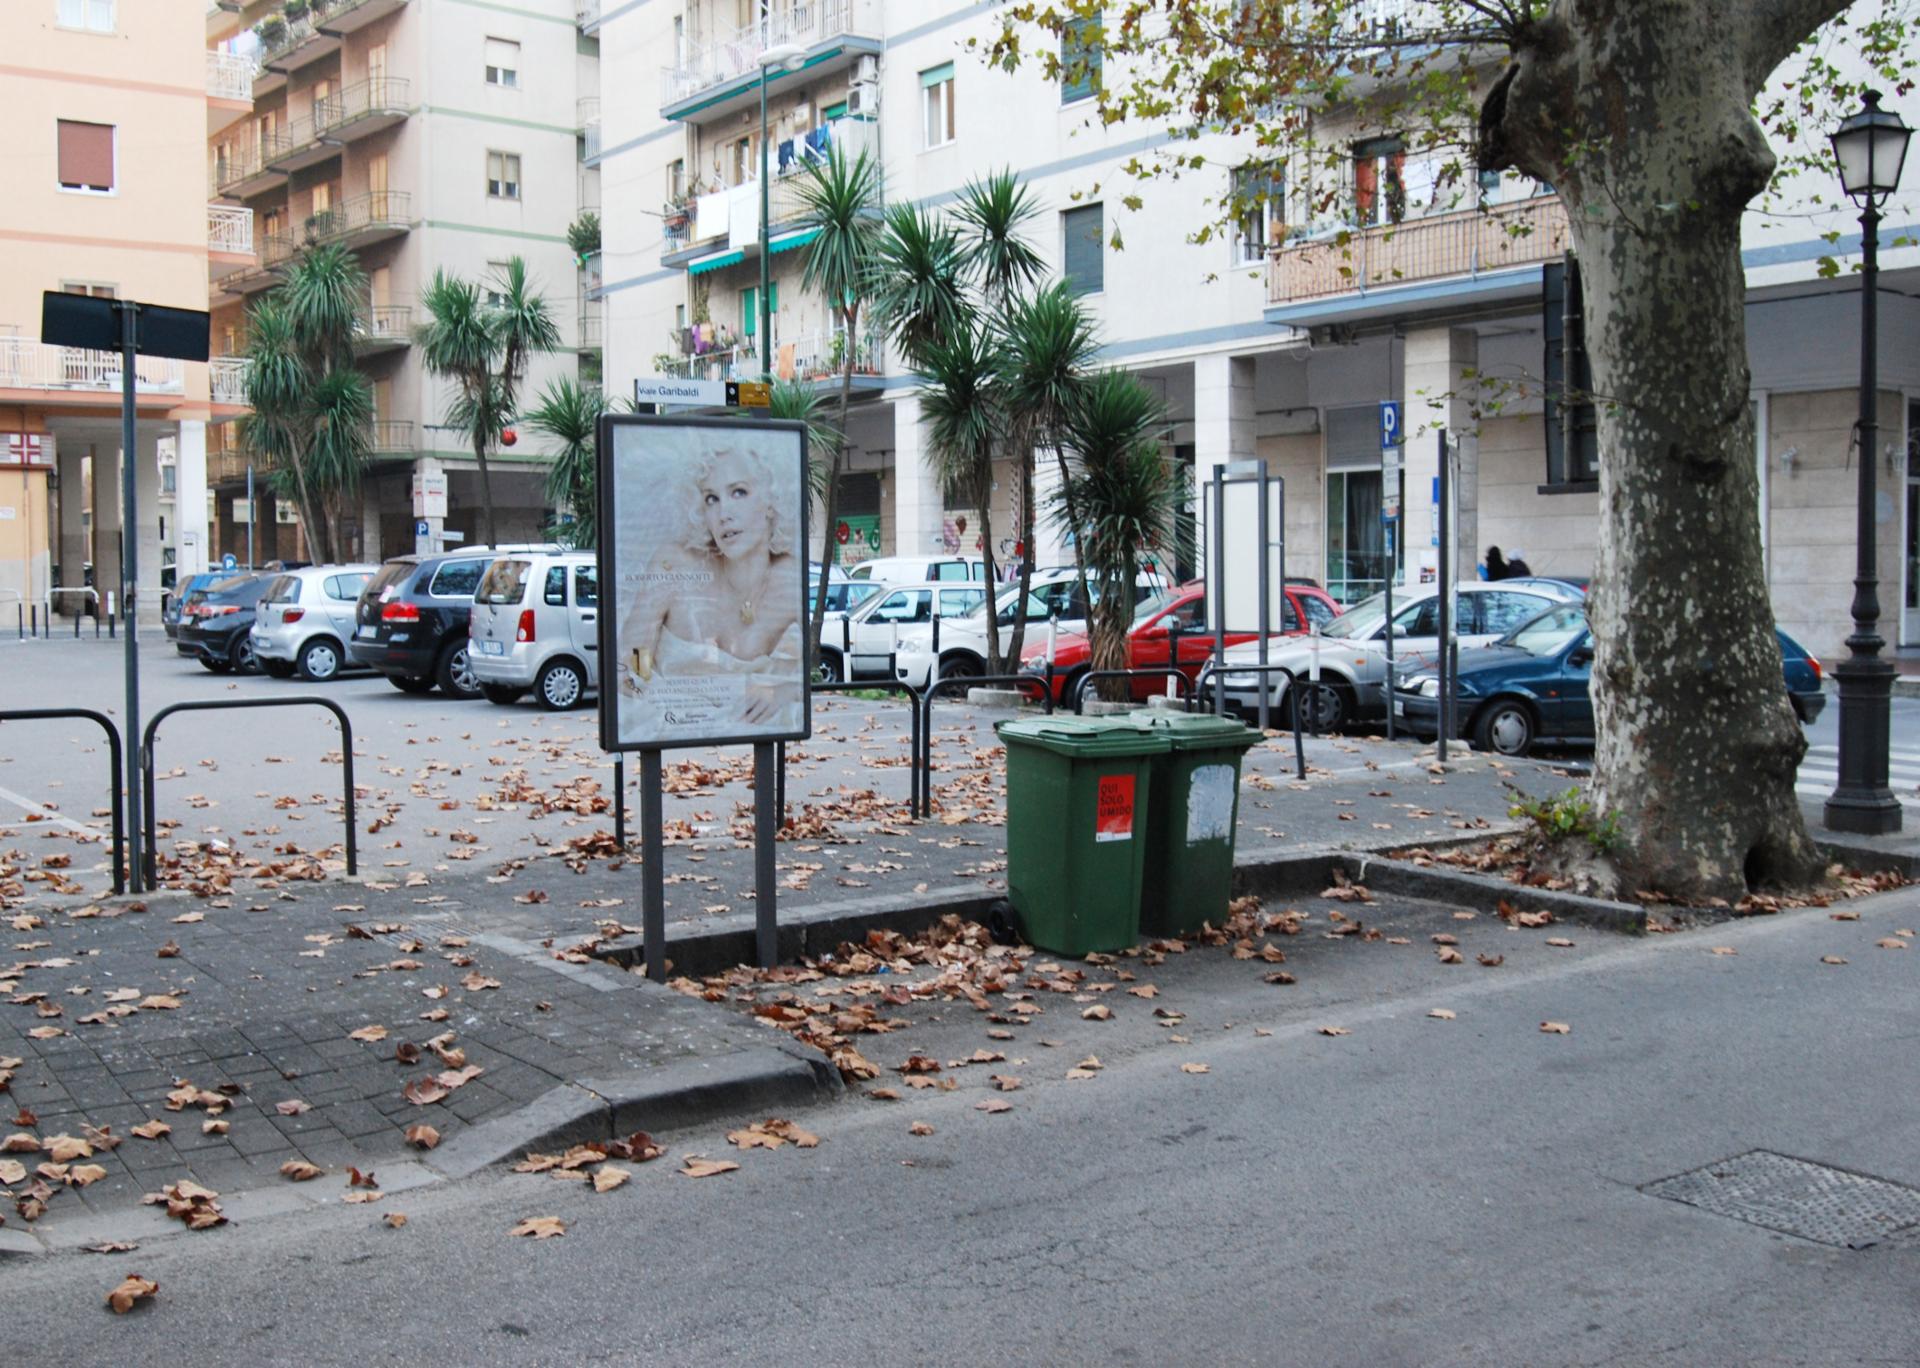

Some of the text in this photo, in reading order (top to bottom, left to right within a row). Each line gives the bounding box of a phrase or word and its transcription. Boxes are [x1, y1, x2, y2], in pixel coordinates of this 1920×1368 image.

[639, 386, 699, 397] Viale Garibaldi
[1383, 405, 1396, 445] P
[418, 523, 428, 536] P
[1101, 783, 1118, 794] QUI
[1100, 794, 1124, 805] SOLO
[1100, 805, 1132, 817] UMIDO
